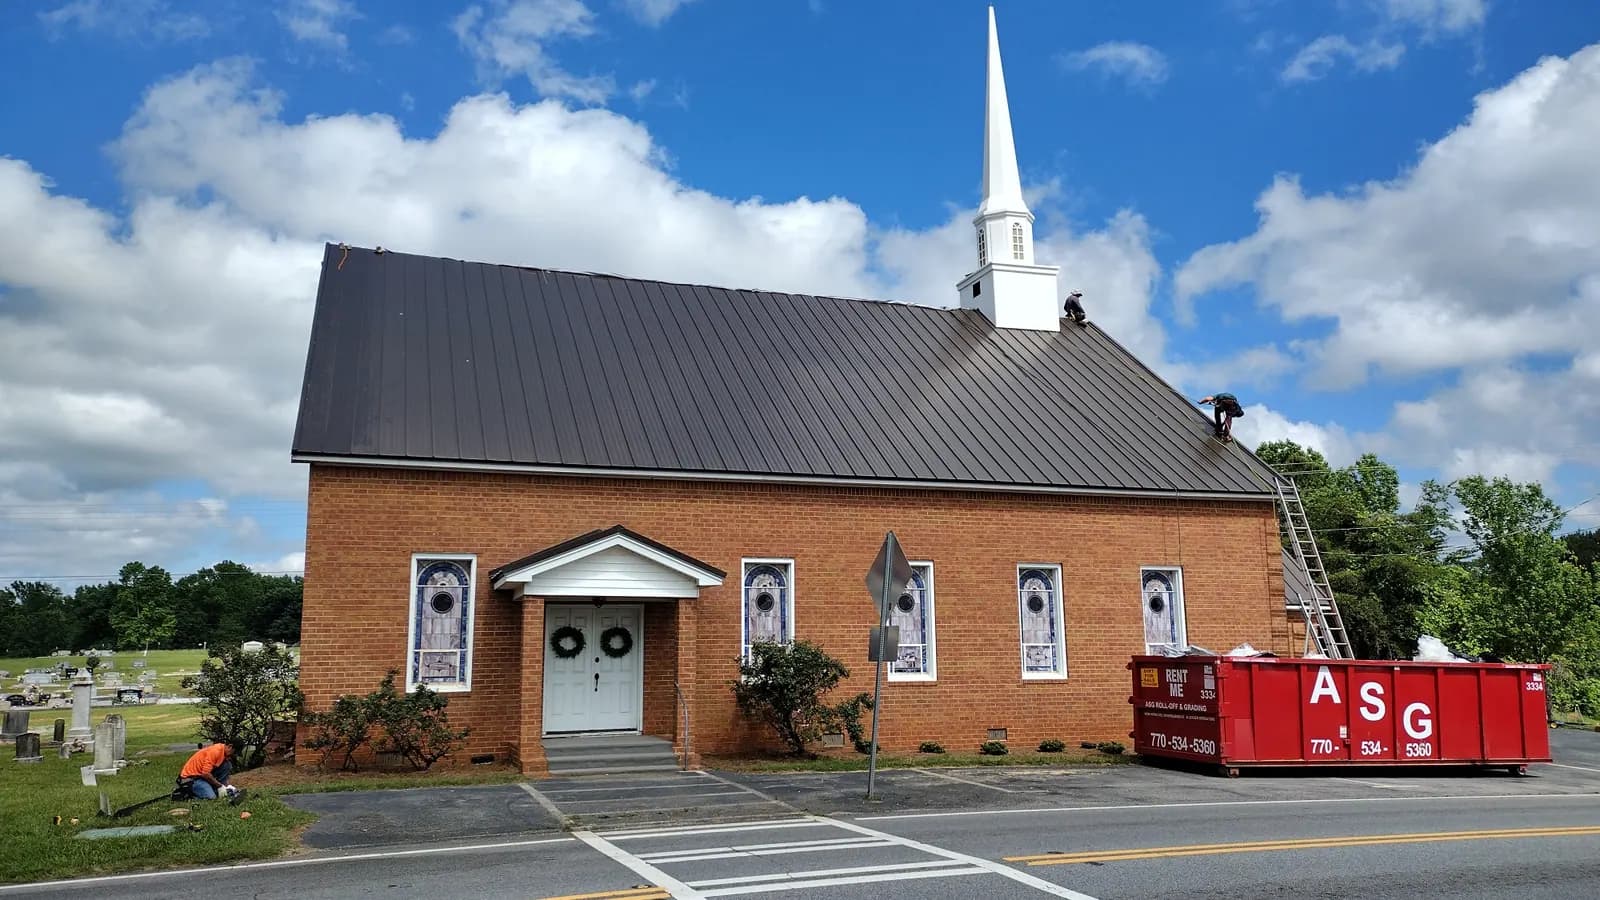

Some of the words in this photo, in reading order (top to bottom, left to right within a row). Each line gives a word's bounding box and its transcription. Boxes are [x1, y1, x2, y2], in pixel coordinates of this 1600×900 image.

[1166, 669, 1188, 683] RENT
[1169, 683, 1184, 697] ME
[1526, 682, 1543, 692] 3334
[1145, 701, 1155, 709] ASG
[1183, 704, 1207, 712] GRADING
[1406, 743, 1432, 757] 5360
